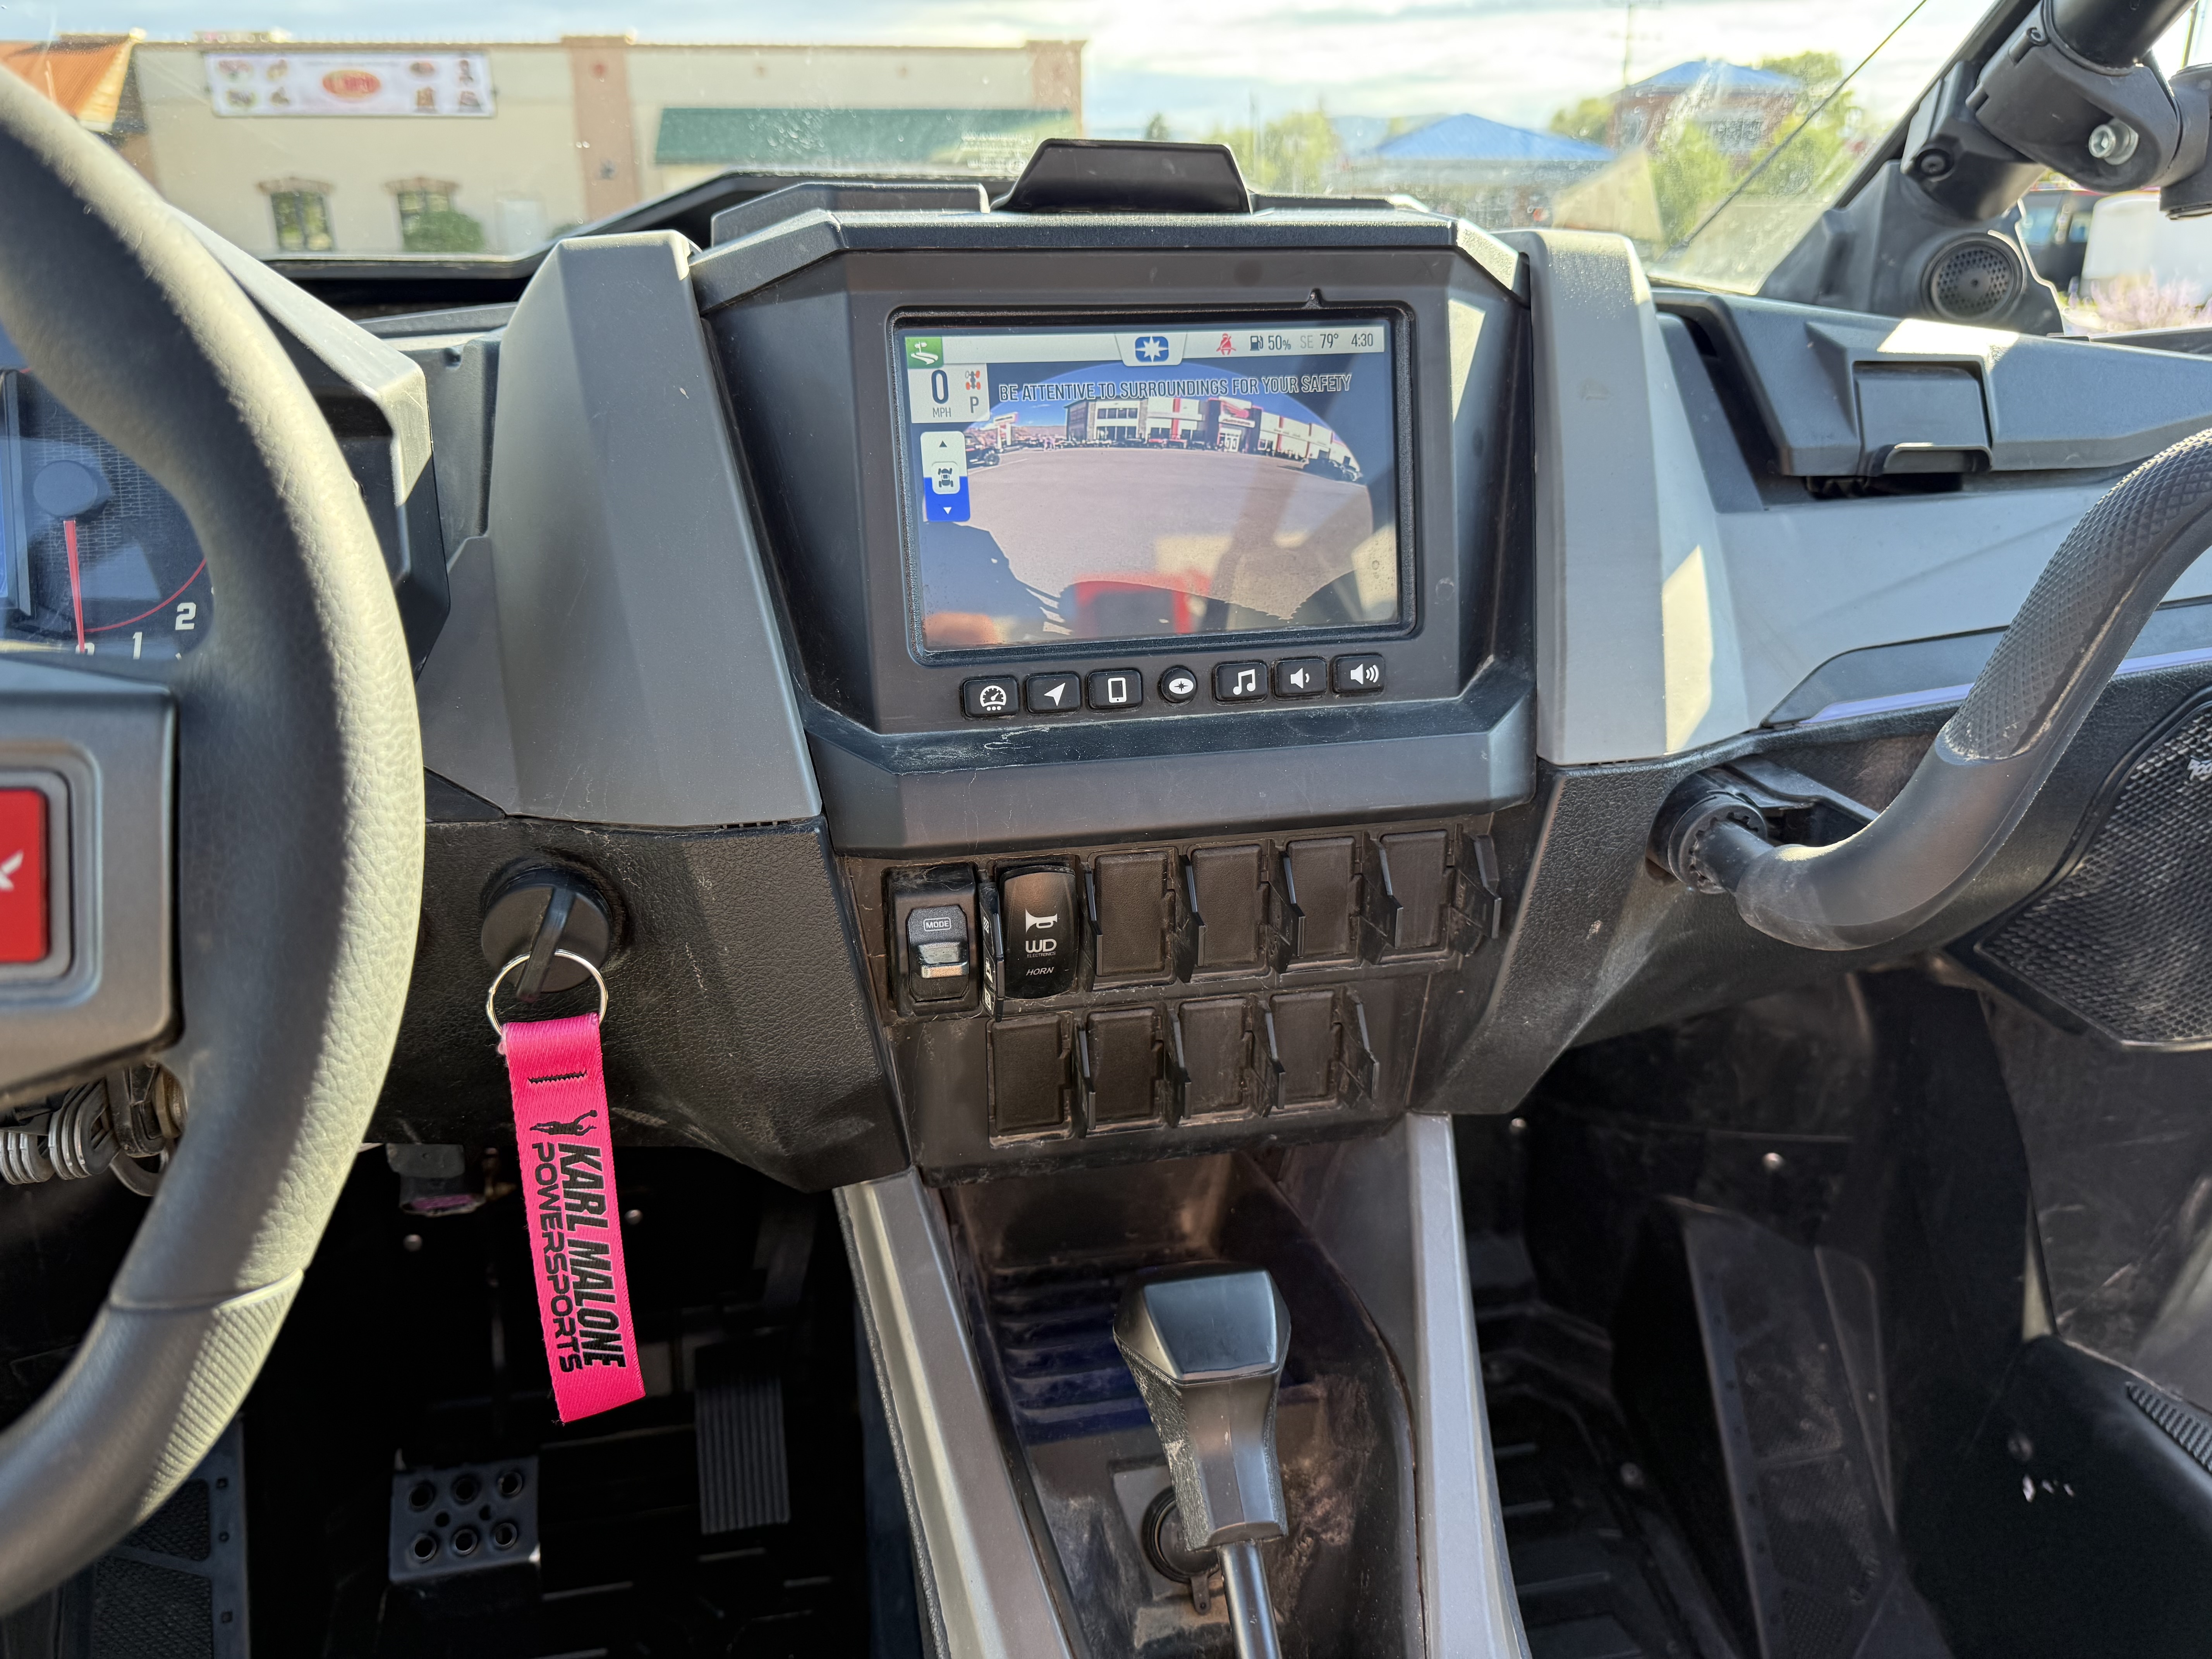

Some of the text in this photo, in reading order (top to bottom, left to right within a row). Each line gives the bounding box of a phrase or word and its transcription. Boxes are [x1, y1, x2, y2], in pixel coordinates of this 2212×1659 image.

[1268, 335, 1291, 350] 50%
[1300, 335, 1314, 349] SE
[1351, 333, 1373, 347] 4:30
[931, 369, 949, 404] 0
[999, 373, 1352, 402] BE ATTENTIVE TO SURROUNDINGS FOR YOUR SAFETY
[933, 407, 951, 417] MPH
[970, 396, 979, 414] P
[175, 603, 196, 630] 2
[132, 632, 143, 659] 1
[926, 921, 950, 929] MODE
[1025, 938, 1057, 953] WD
[1026, 967, 1054, 975] HORN
[532, 1142, 583, 1373] POWERSPORTS
[558, 1142, 626, 1368] KARL MALONE
